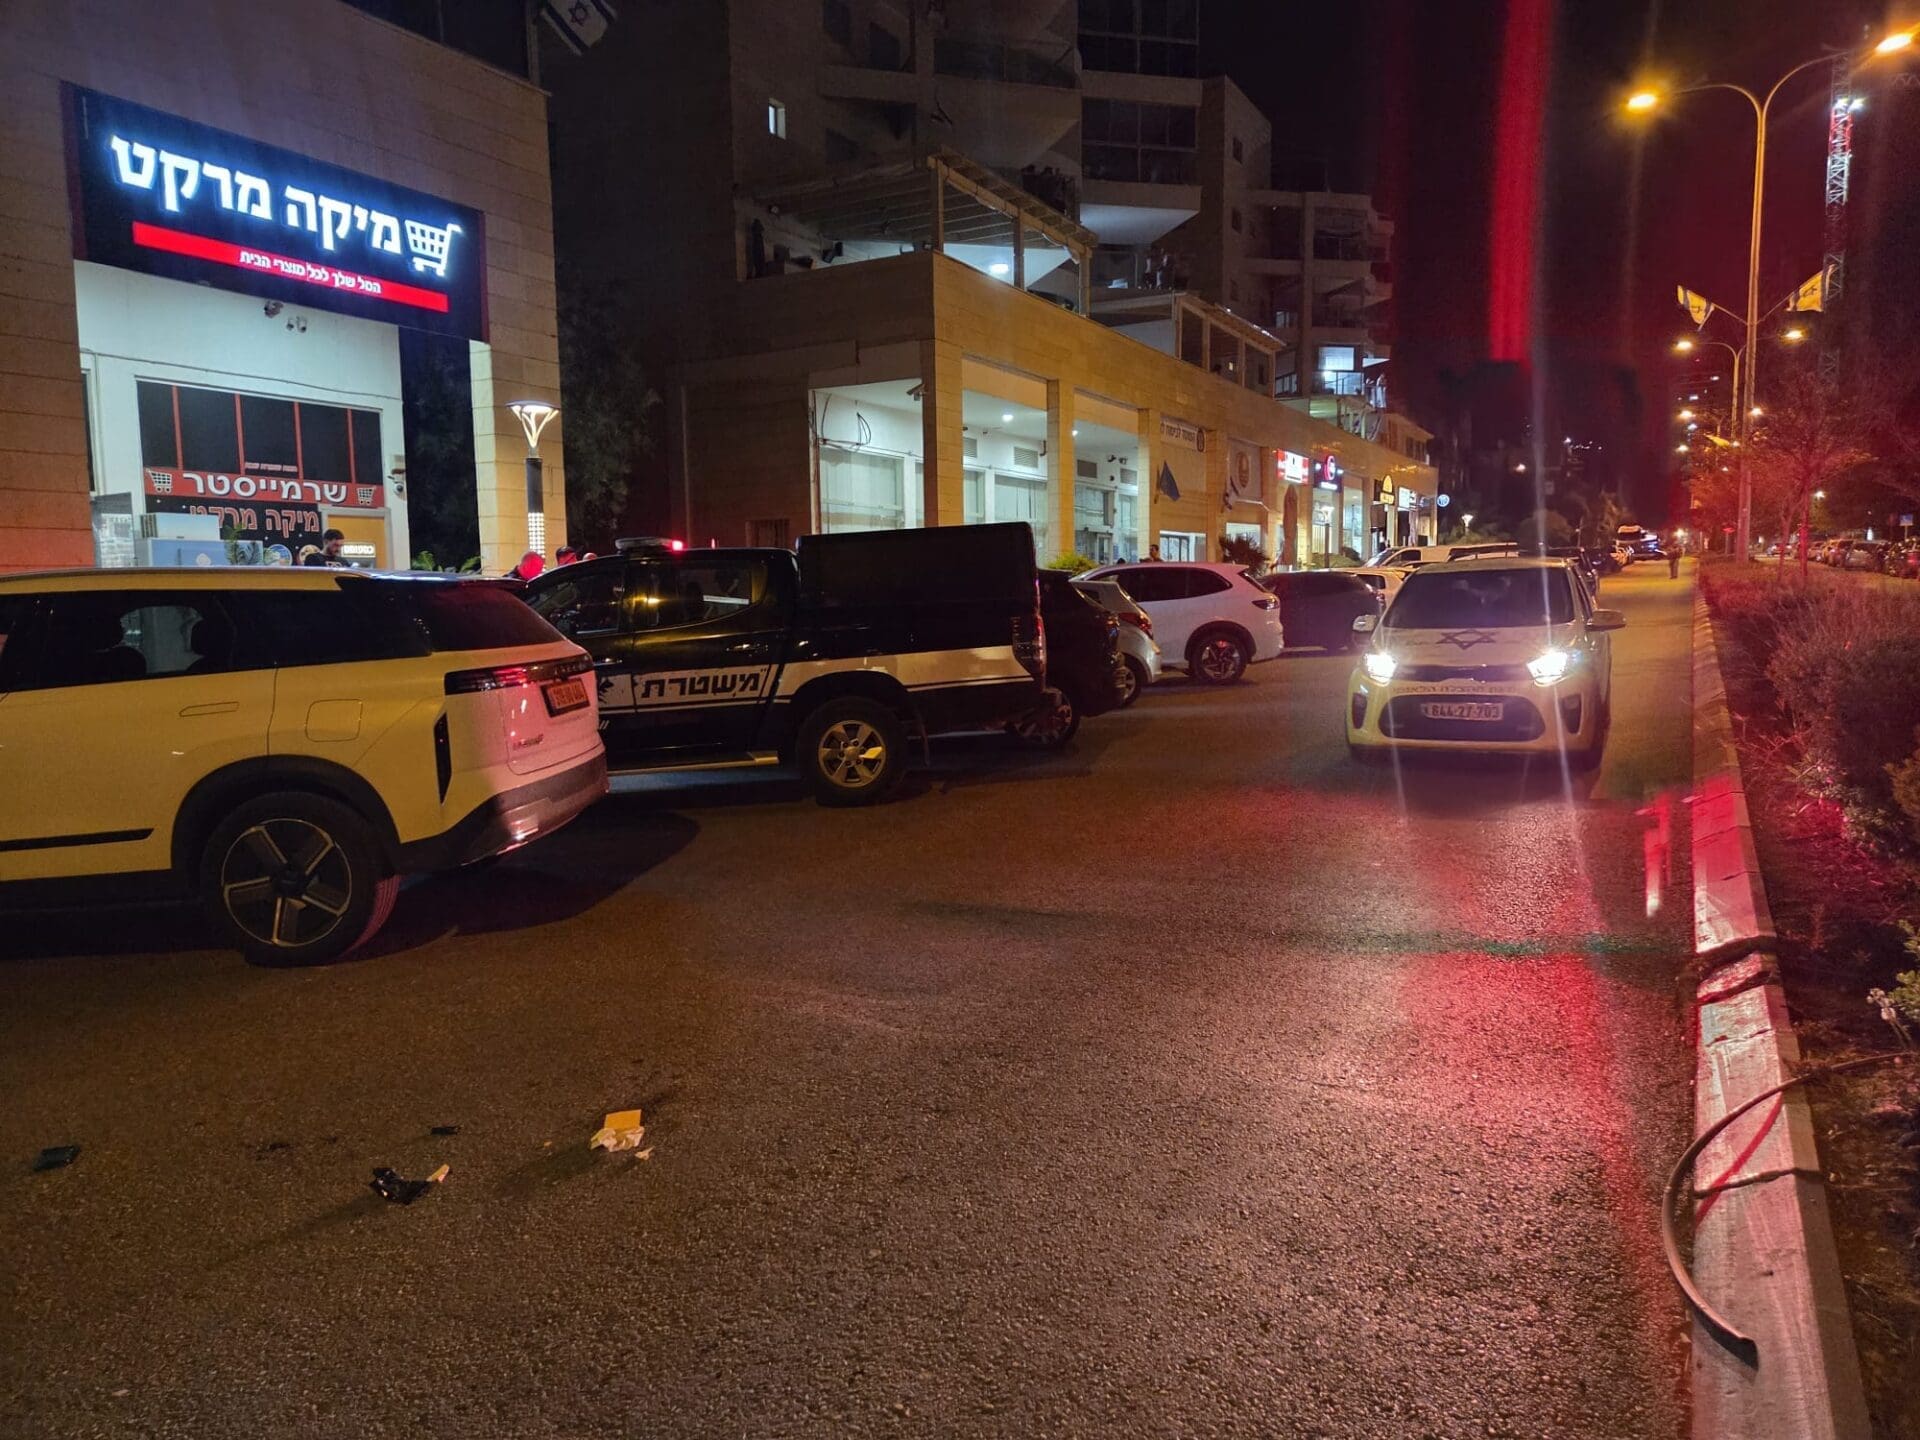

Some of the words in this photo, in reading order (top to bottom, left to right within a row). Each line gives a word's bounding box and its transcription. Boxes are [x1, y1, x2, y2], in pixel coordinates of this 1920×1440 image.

[110, 135, 272, 221] מרקט
[284, 184, 400, 254] מיקה
[239, 250, 271, 269] הבית
[273, 258, 306, 277] מוצרי
[307, 262, 330, 282] לכל
[332, 271, 356, 288] שלך
[357, 275, 381, 294] הסל
[183, 472, 347, 504] שרמייסטר
[266, 508, 320, 539] מיקה
[642, 672, 760, 699] משטרת
